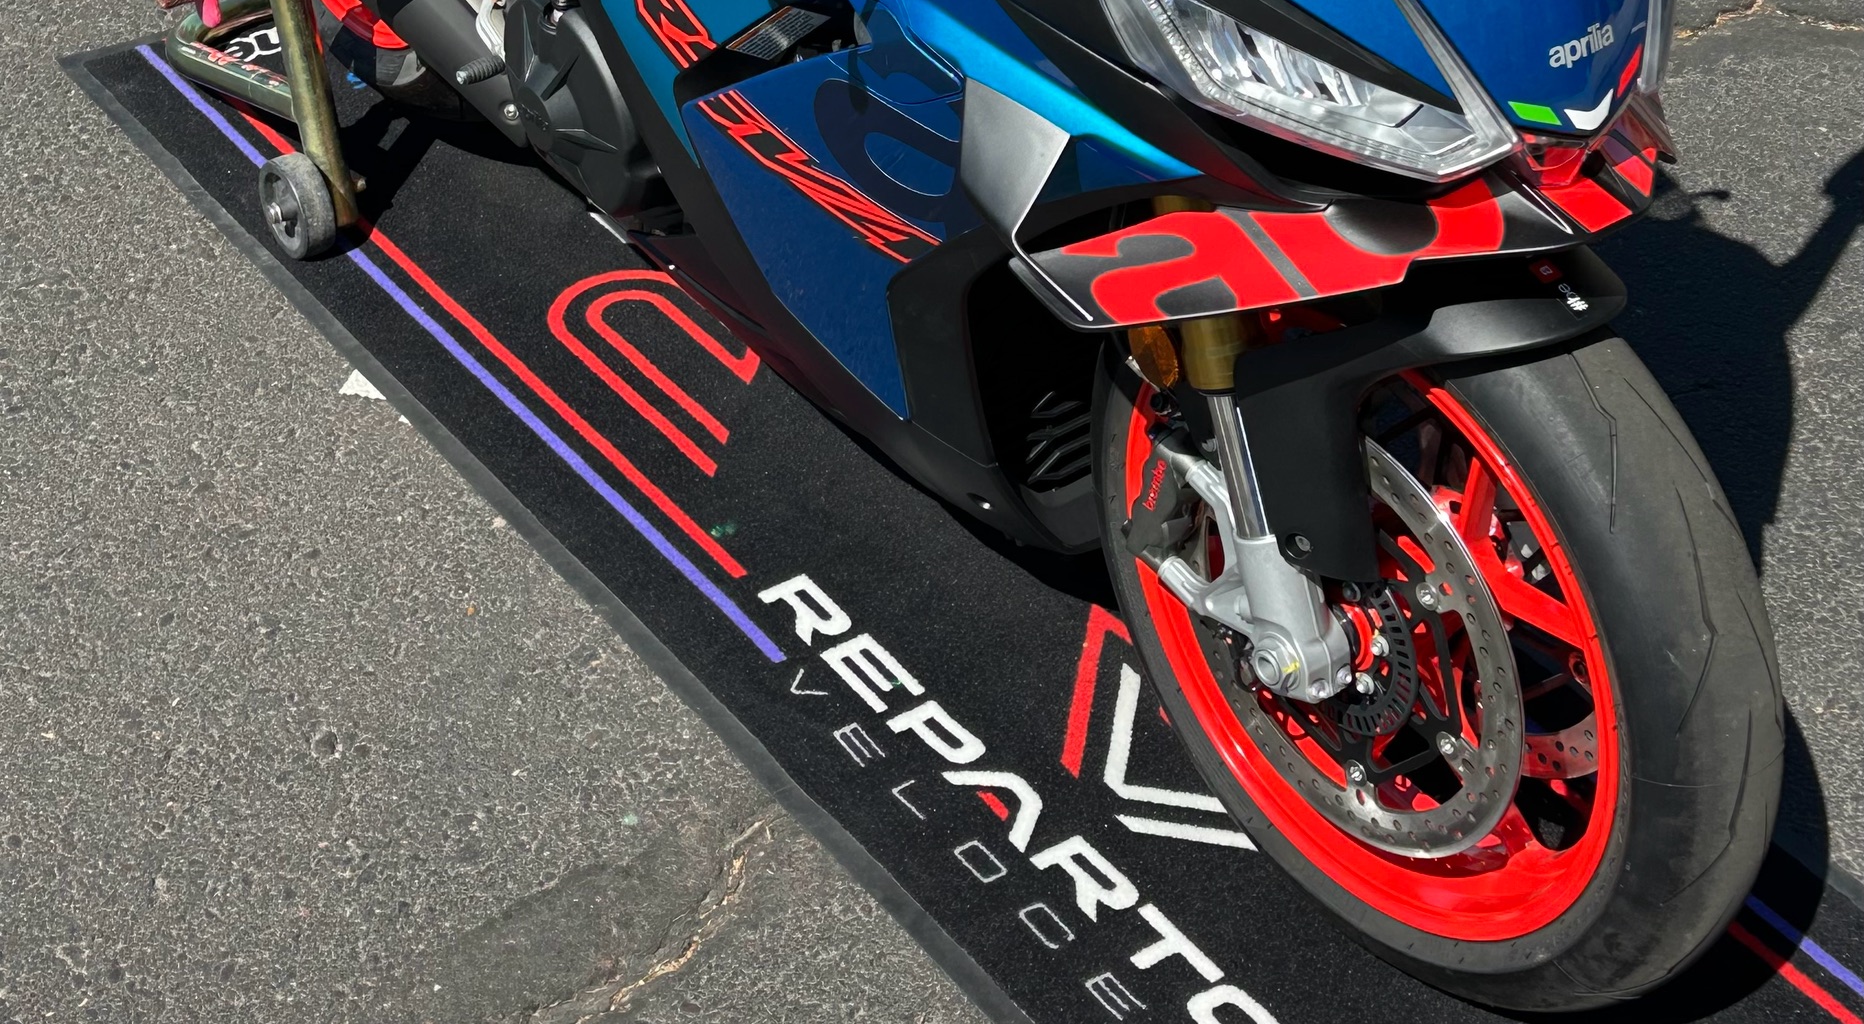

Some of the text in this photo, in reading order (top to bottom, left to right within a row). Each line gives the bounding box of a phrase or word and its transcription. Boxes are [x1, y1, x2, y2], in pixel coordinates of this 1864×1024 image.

[1548, 23, 1614, 69] aprilia
[1141, 459, 1167, 512] brembo
[790, 669, 1147, 1021] VELOCE
